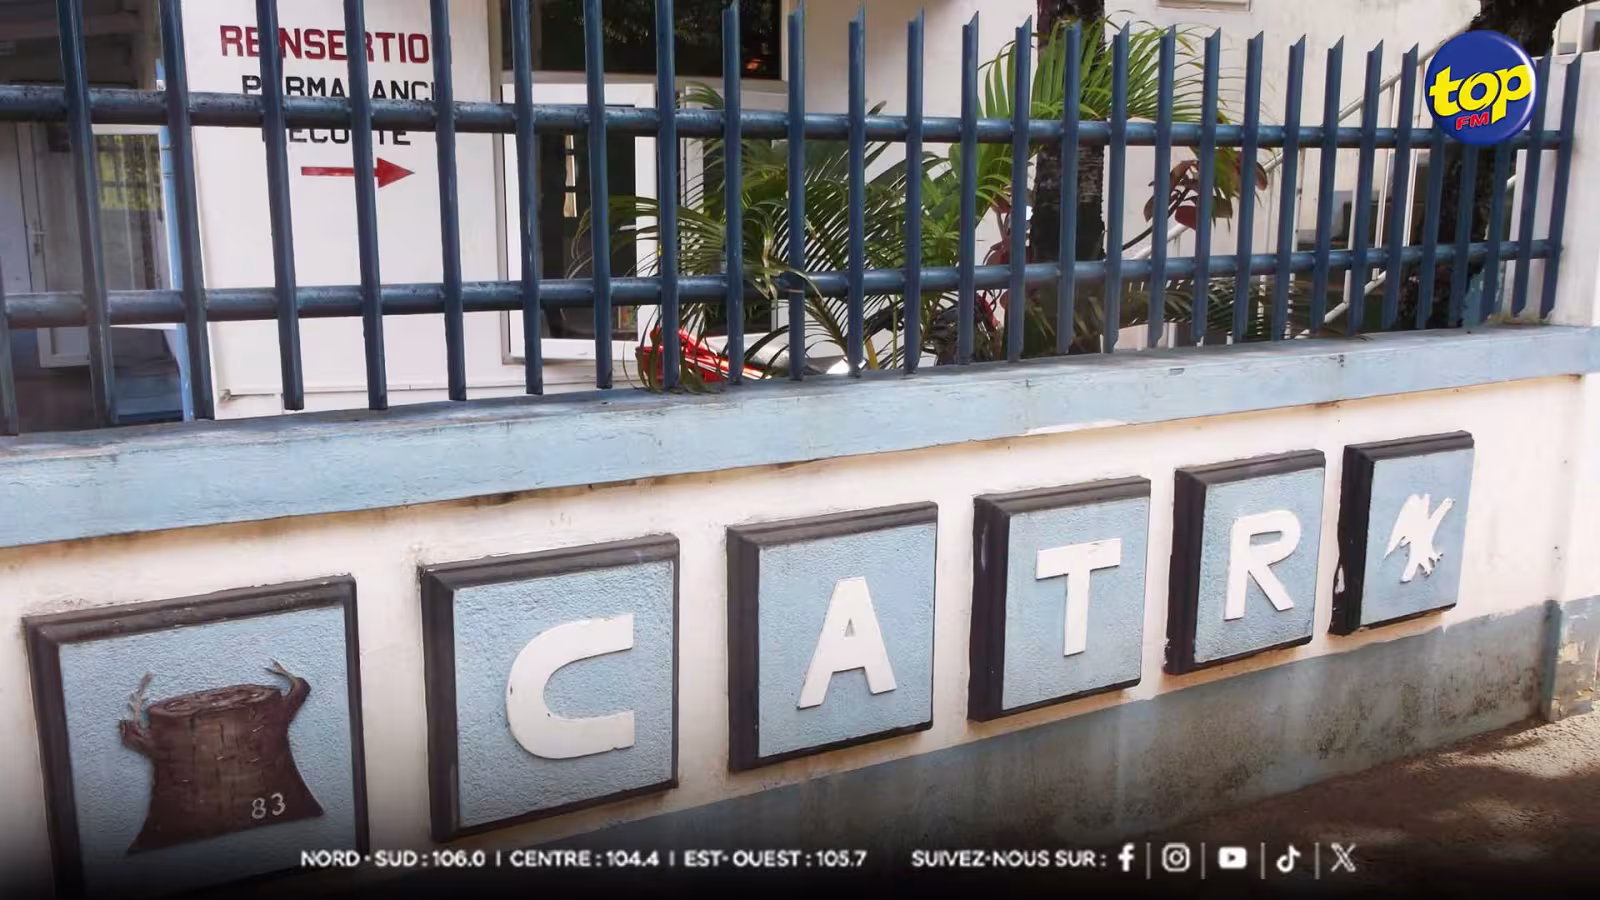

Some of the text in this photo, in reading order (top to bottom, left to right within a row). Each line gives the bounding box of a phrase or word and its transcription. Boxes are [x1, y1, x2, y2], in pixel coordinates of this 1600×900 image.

[220, 25, 430, 64] RENSETIO
[242, 75, 435, 101] PRMAANC
[251, 792, 286, 820] 83
